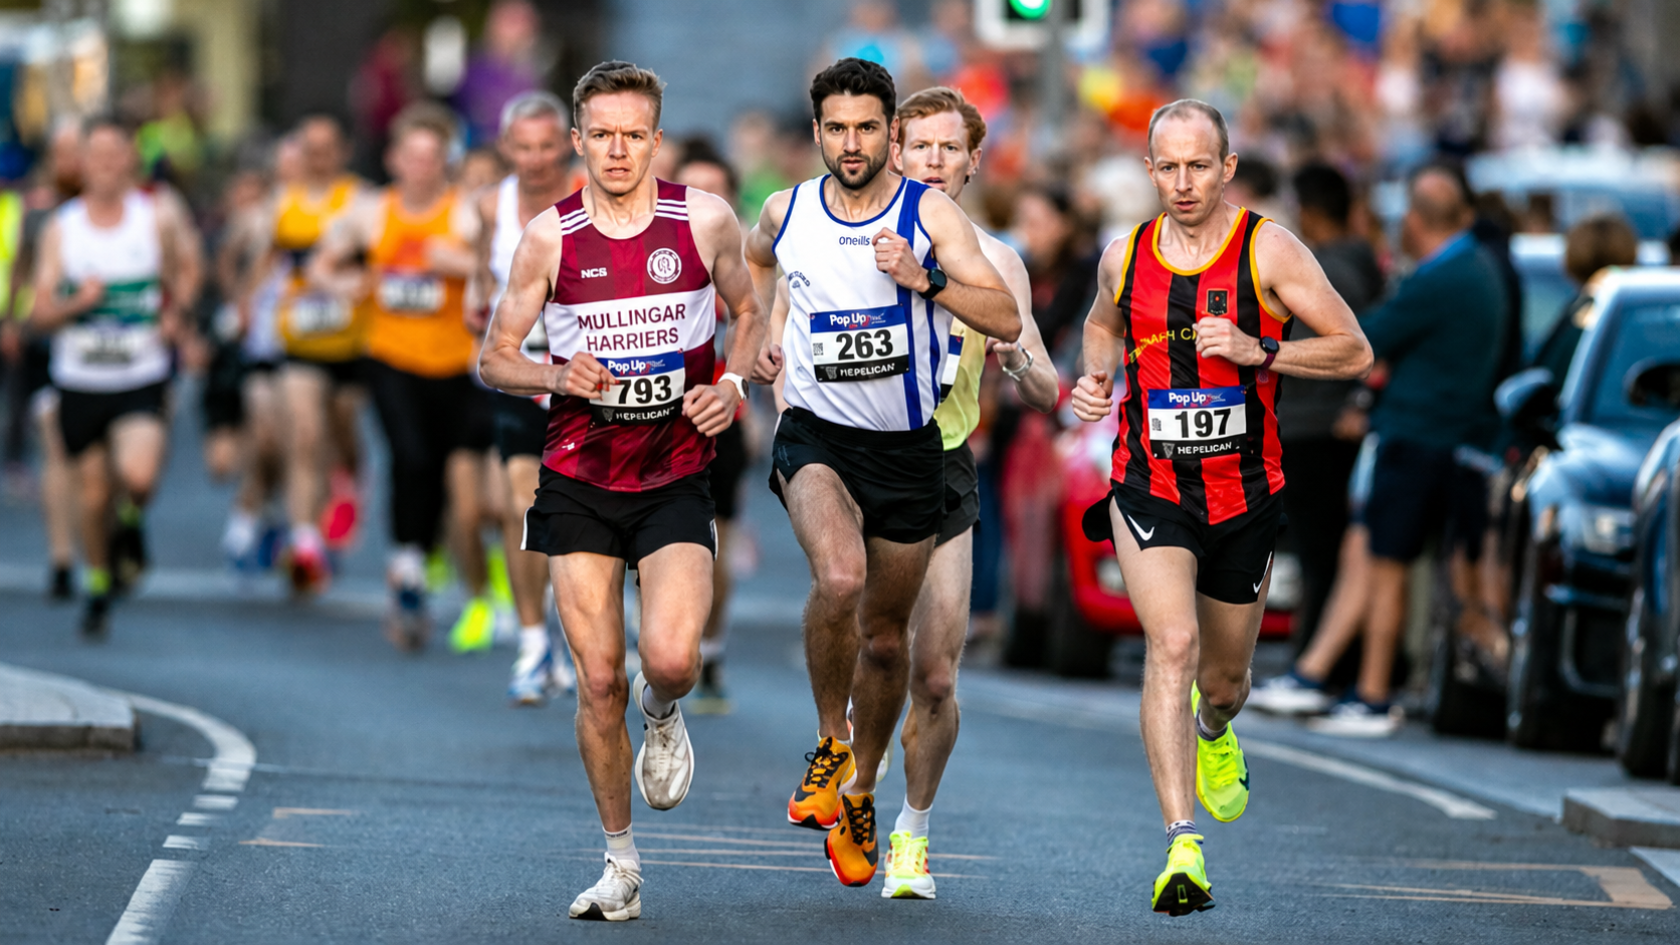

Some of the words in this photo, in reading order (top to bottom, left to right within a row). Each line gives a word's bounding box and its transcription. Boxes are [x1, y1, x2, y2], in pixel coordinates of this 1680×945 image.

[580, 267, 608, 279] NCS
[577, 303, 686, 330] MULLINGAR
[829, 314, 850, 327] Pop
[851, 312, 867, 326] Up
[586, 327, 679, 351] HARRIERS
[836, 329, 894, 361] 263
[607, 359, 630, 375] Pop
[630, 359, 646, 373] Up
[616, 374, 672, 405] 793
[1168, 392, 1190, 407] Pop
[1191, 391, 1207, 405] Up
[1175, 408, 1231, 438] 197
